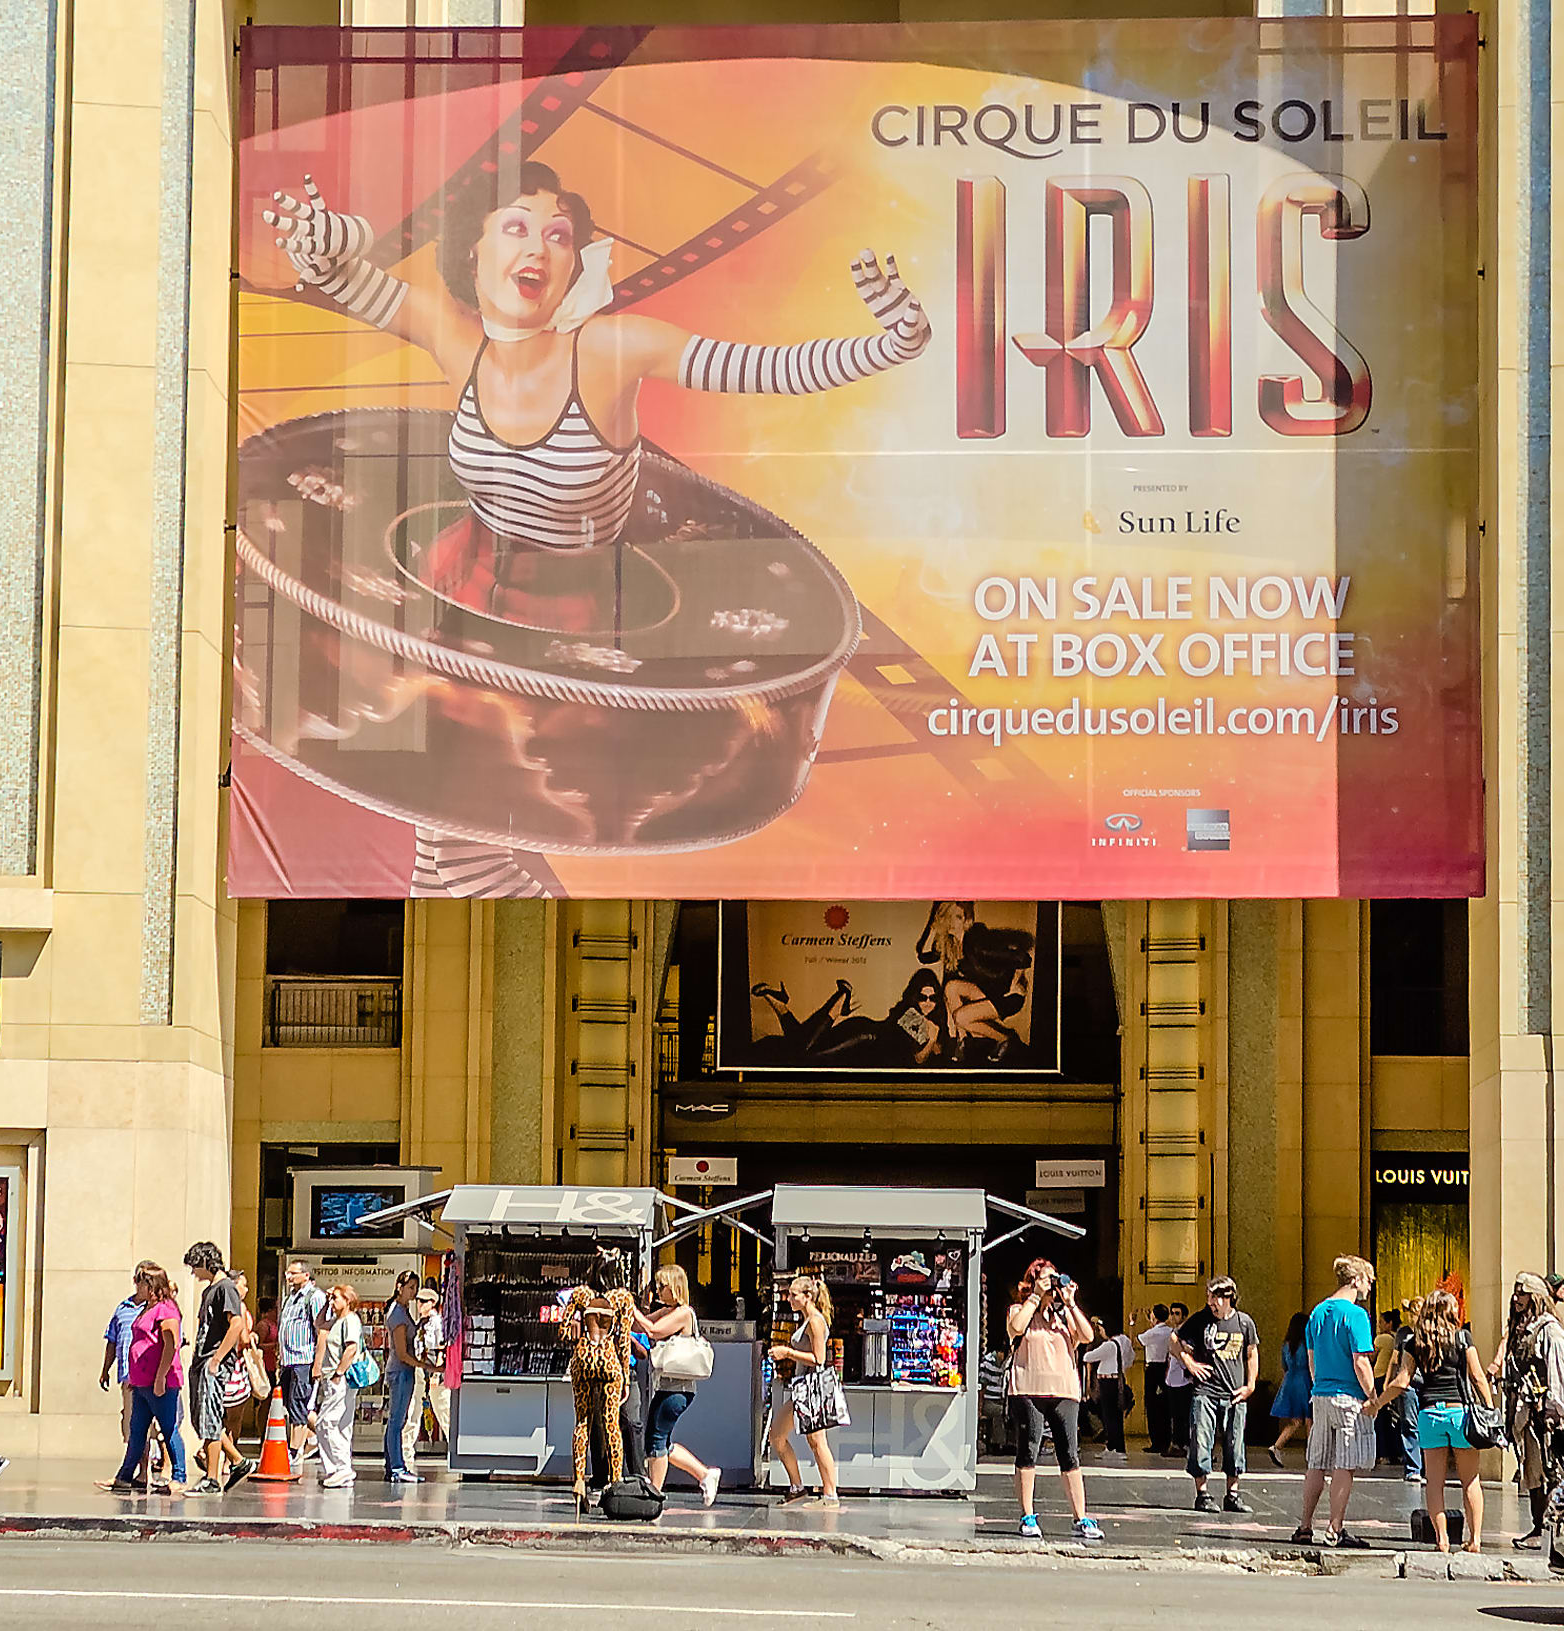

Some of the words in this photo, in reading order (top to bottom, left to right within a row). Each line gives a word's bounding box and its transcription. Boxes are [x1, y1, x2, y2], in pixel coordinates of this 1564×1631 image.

[871, 103, 1102, 159] CIRQUE
[1128, 102, 1209, 145] DU
[1233, 99, 1448, 142] SOLEIL
[956, 172, 1373, 439] IRIS
[1132, 485, 1177, 493] PRESENTED
[1179, 485, 1189, 493] BY
[1118, 510, 1177, 534] Sun
[1185, 508, 1241, 534] Life
[973, 576, 1057, 620] ON
[1072, 576, 1193, 620] SALE
[1209, 576, 1351, 619] NOW
[968, 633, 1038, 677] AT
[1052, 633, 1166, 677] BOX
[1178, 632, 1356, 677] OFFICE
[927, 696, 1399, 747] cirquedusoleil.com/iris
[1091, 838, 1157, 847] INFINITI
[781, 933, 834, 946] Carmen
[838, 933, 892, 949] Steffens
[675, 1103, 729, 1112] MAC
[1039, 1170, 1064, 1178] LOUIS
[1065, 1169, 1102, 1177] VUITTON
[1376, 1169, 1425, 1184] LOUIS
[810, 1251, 878, 1262] PERSONALIZED
[341, 1267, 395, 1276] INFORMATION
